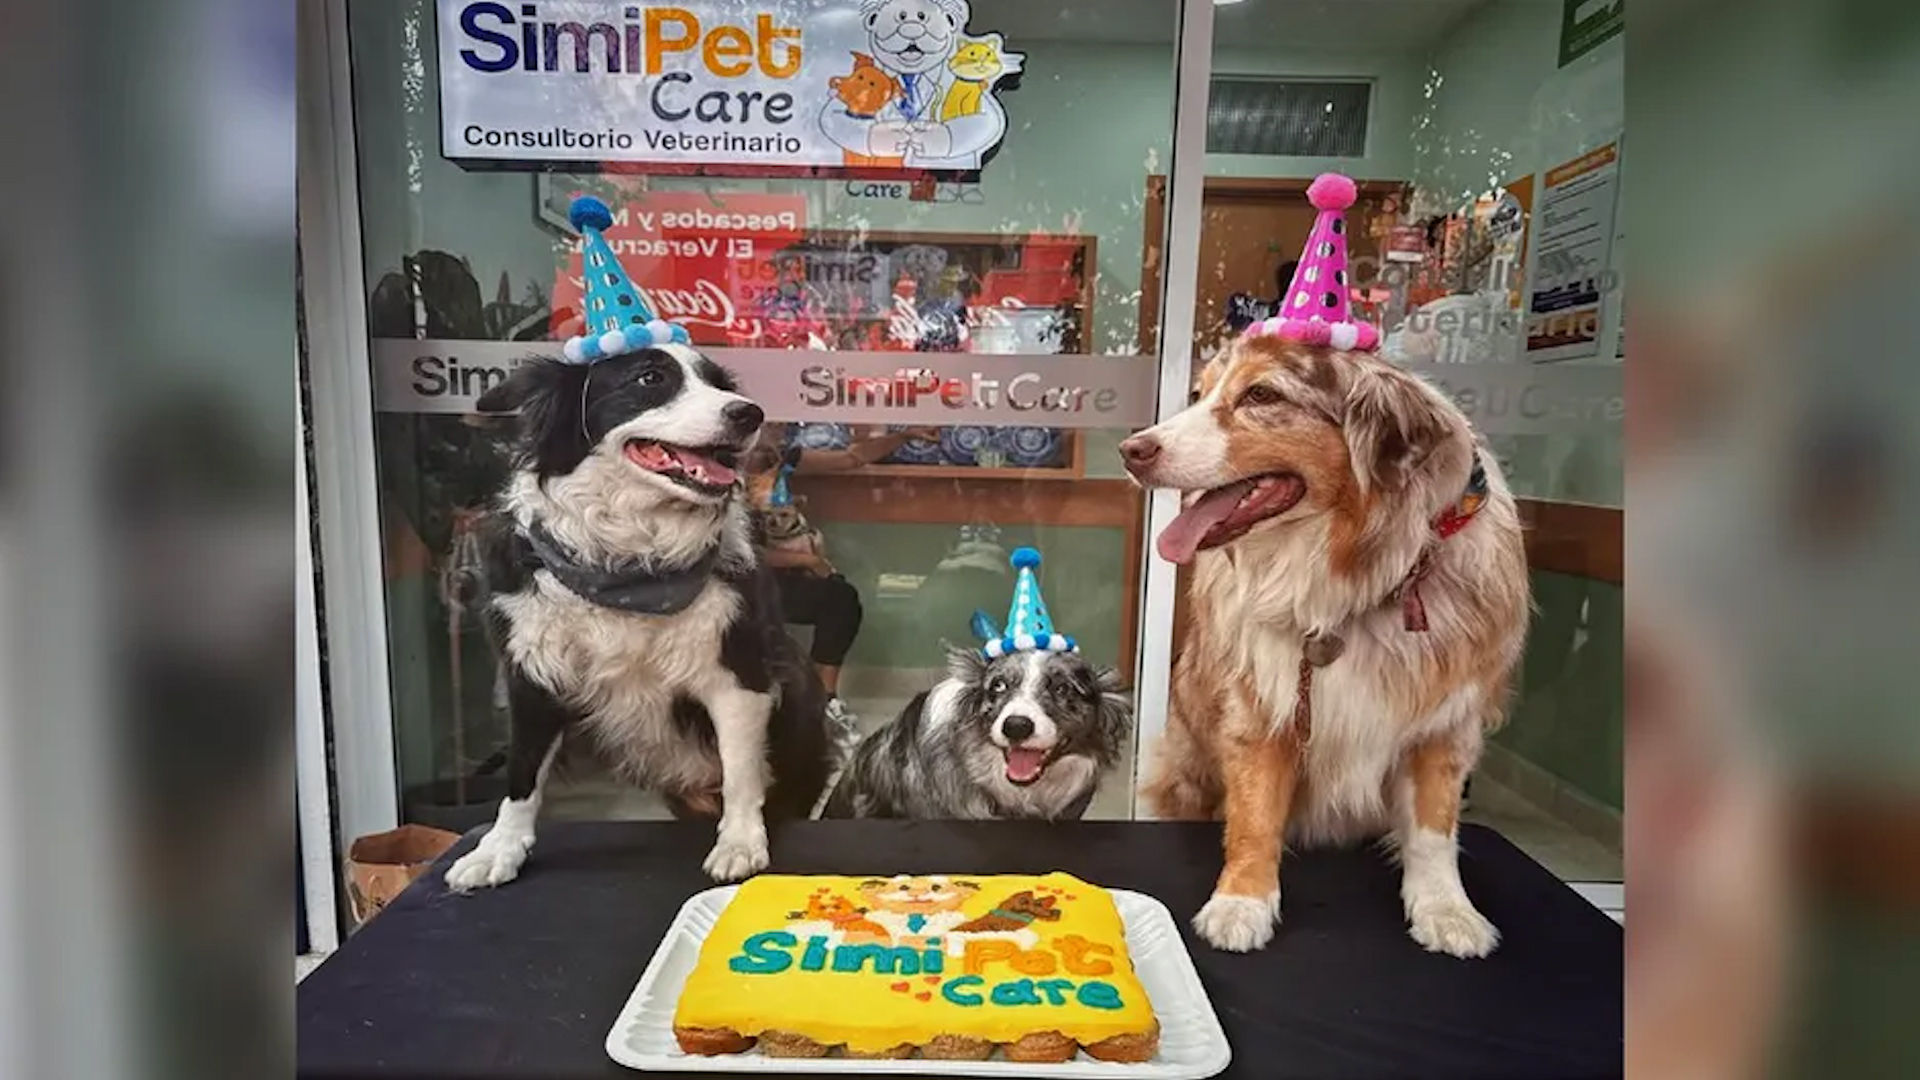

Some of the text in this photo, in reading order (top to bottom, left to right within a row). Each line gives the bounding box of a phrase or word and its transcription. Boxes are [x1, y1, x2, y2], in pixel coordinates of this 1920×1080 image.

[460, 1, 802, 79] SimiPet
[652, 73, 794, 123] Care
[464, 125, 801, 154] Consultorio Veterinario
[845, 178, 902, 199] Care
[800, 364, 1118, 413] SimiPet Care
[729, 931, 1114, 977] Simi Pet
